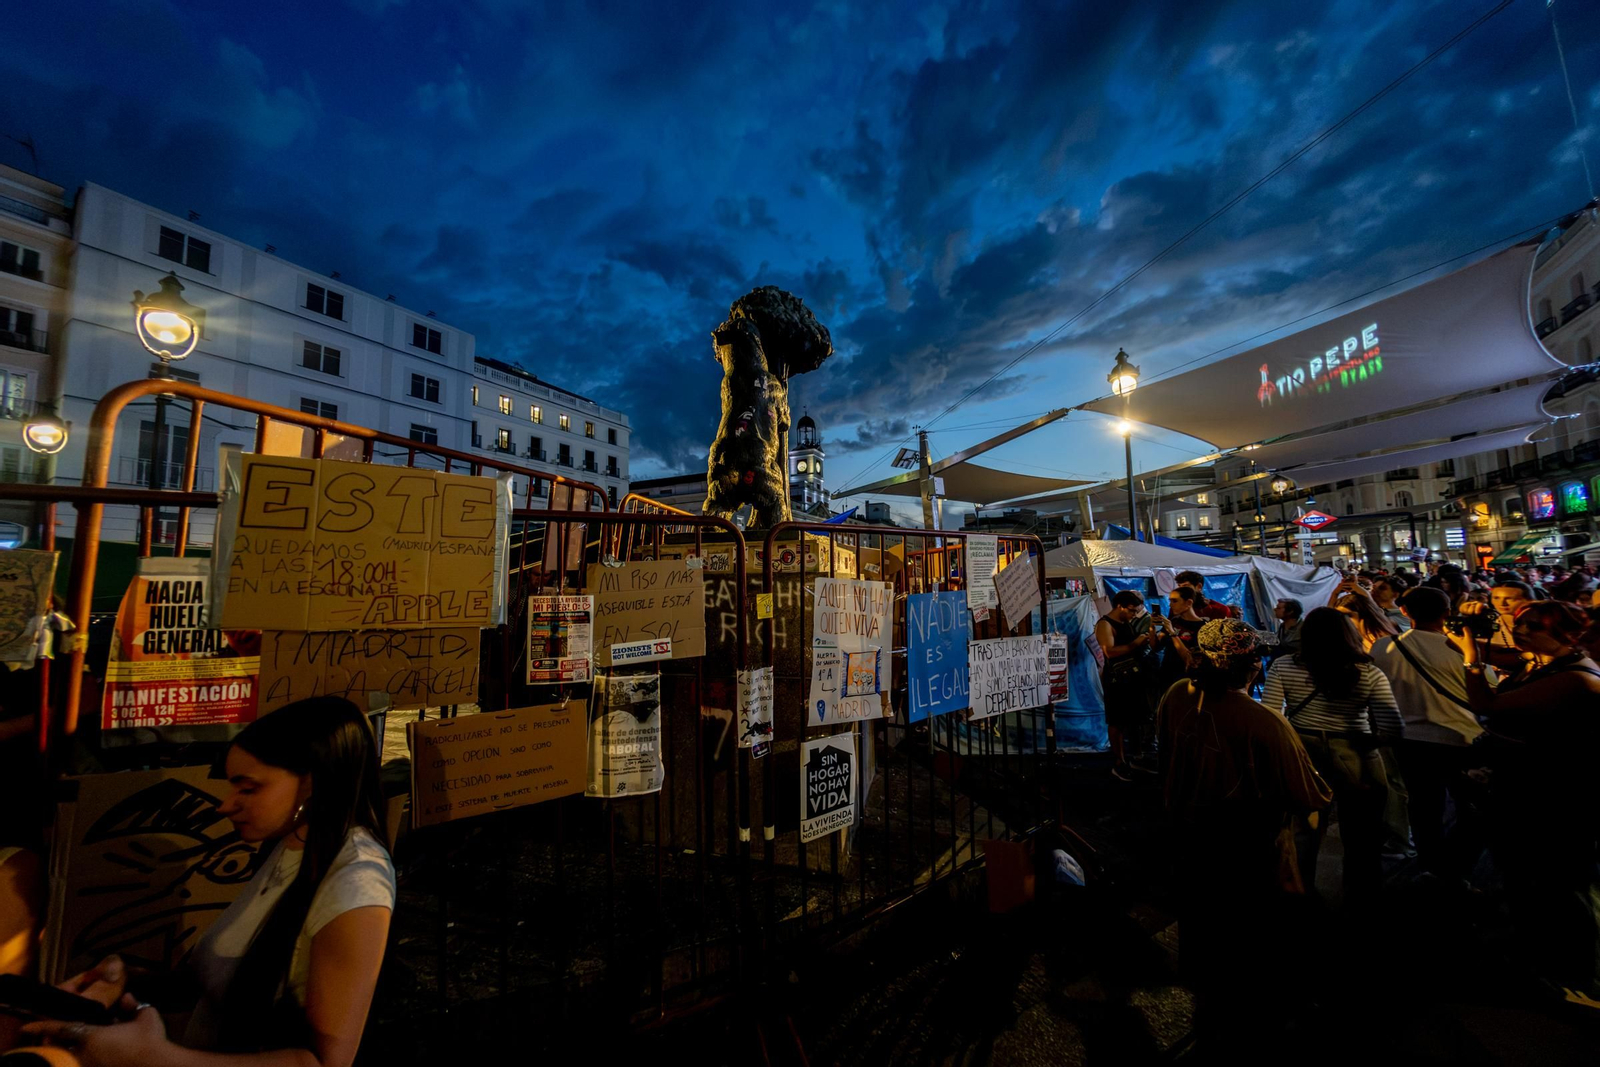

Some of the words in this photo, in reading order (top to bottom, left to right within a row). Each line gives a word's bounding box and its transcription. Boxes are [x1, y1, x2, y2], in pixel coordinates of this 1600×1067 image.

[1276, 367, 1305, 398] TIO
[1309, 322, 1379, 381] PEPE
[239, 462, 496, 539] ESTE
[233, 534, 367, 560] QUEDAMOS
[231, 555, 244, 570] A
[262, 558, 306, 574] LAS
[145, 580, 204, 604] HACIA
[228, 577, 259, 594] EN
[270, 581, 289, 595] LA
[380, 583, 398, 594] DE
[598, 571, 620, 594] MI
[631, 569, 658, 590] PISO
[362, 590, 490, 625] APPLE
[533, 603, 544, 612] MI
[595, 598, 656, 618] ASEQUIBLE
[817, 582, 848, 610] AQUI
[853, 584, 868, 613] NO
[869, 586, 893, 616] HAY
[150, 605, 209, 629] HUEL
[820, 611, 852, 635] QUIEN
[853, 613, 881, 640] VIVA
[909, 596, 967, 649] NADIE
[143, 629, 226, 655] GENERAL
[602, 625, 630, 649] EN
[612, 644, 652, 655] ZIONISTS
[627, 650, 652, 659] WELCOME
[926, 648, 944, 664] ES
[970, 643, 993, 662] TRAS
[993, 641, 1010, 659] ESTA
[827, 667, 833, 680] A
[112, 681, 252, 707] MANIFESTACIÓN
[267, 675, 293, 703] A
[911, 667, 970, 714] ILEGAL
[973, 682, 982, 700] SI
[985, 689, 1018, 715] DEPENDE
[1018, 687, 1030, 708] DE
[111, 707, 118, 719] 3
[121, 706, 147, 719] OCT.
[154, 704, 175, 716] 12H
[831, 699, 873, 720] MADRID
[425, 728, 493, 747] RADICALIZARSE
[500, 725, 513, 735] NO
[518, 722, 528, 732] SE
[533, 717, 571, 730] PRESENTA
[616, 729, 627, 737] de
[532, 741, 553, 751] COMO
[602, 742, 655, 755] LABORAL
[821, 752, 838, 767] SIN
[431, 773, 492, 794] NECESIDAD
[495, 770, 513, 781] PARA
[809, 762, 850, 783] HOGAR
[809, 782, 827, 797] NO
[828, 774, 850, 791] HAY
[435, 803, 453, 813] ESTE
[458, 796, 488, 809] SISTEMA
[490, 794, 500, 803] DE
[503, 788, 532, 799] MUERTE
[809, 787, 849, 814] VIDA
[802, 822, 814, 833] LA
[815, 808, 852, 828] VIVIENDA
[802, 831, 812, 840] NO
[812, 829, 819, 837] ES
[820, 825, 828, 833] UN
[828, 816, 853, 830] NEGOCIO
